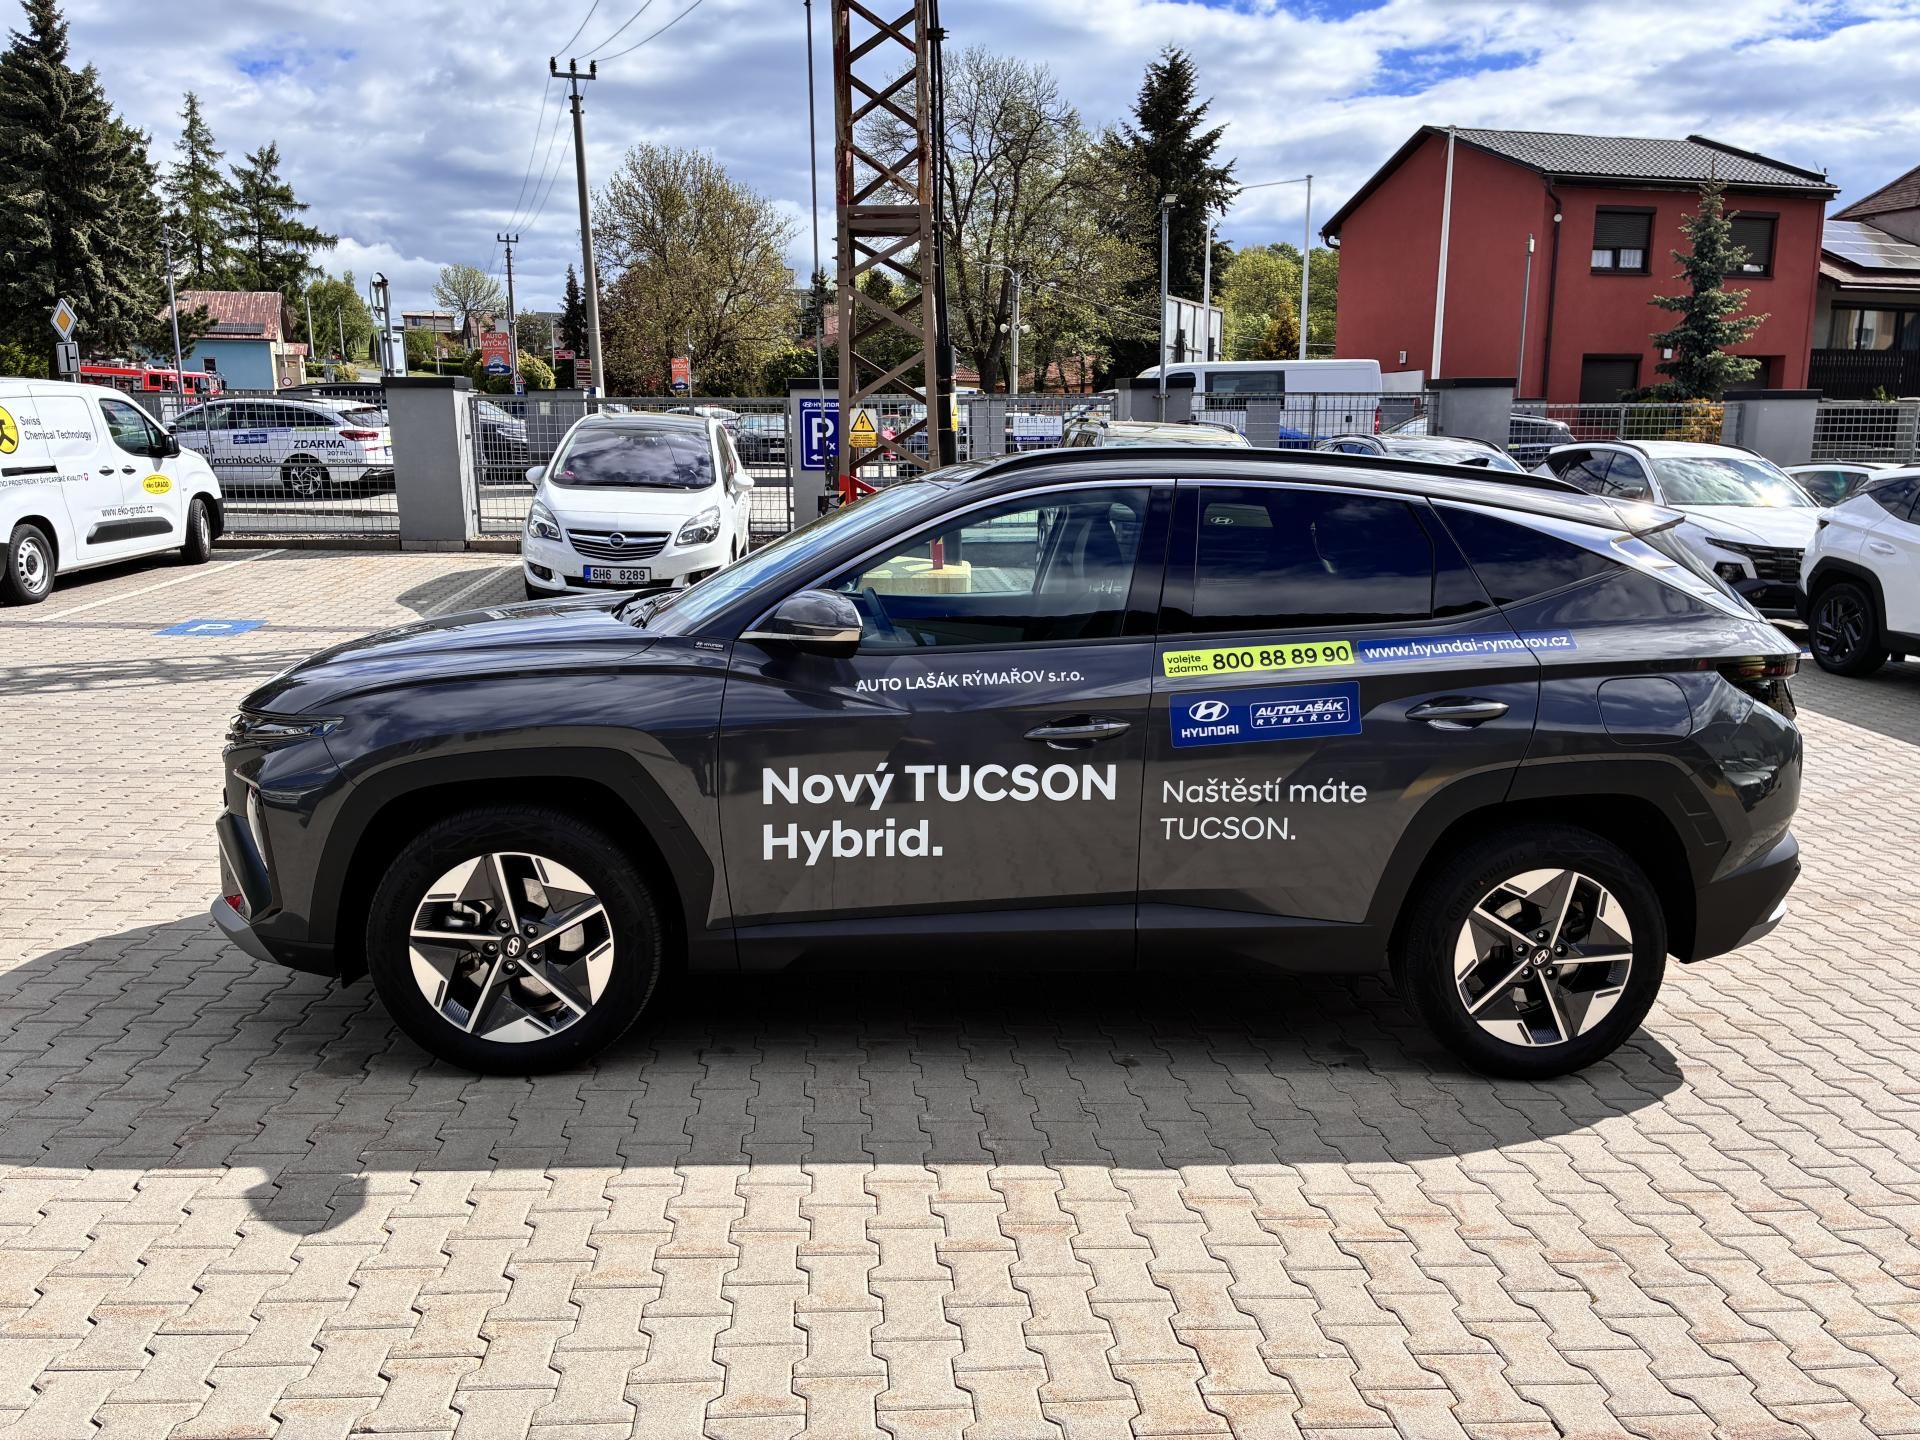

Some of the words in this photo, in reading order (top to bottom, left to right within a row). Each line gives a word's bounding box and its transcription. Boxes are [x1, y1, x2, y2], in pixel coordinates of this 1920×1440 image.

[482, 339, 508, 347] MYČKA
[20, 416, 41, 426] Swiss
[24, 430, 55, 440] Chemical
[56, 430, 92, 441] Technology
[811, 417, 835, 450] P
[294, 440, 345, 449] ZDARMA
[101, 505, 153, 518] www.eko-grado.cz
[592, 568, 612, 580] 6H6
[619, 569, 646, 581] 8289
[1364, 633, 1571, 660] www.hyundai-rymarov.cz
[1167, 654, 1202, 665] volejte
[1212, 651, 1254, 670] 800
[1259, 649, 1287, 667] 88
[1291, 647, 1318, 664] 89
[1322, 645, 1350, 662] 90
[1168, 664, 1209, 674] zdarma
[855, 677, 903, 693] AUTO
[905, 671, 960, 691] LAŠÁK
[962, 667, 1046, 688] RÝMAŘOV
[1047, 670, 1085, 684] s.r.o.
[1254, 698, 1344, 717] AUTOLAŠÁK
[1256, 712, 1346, 726] RÝMAŘOV
[1181, 724, 1240, 739] HYUNDAI
[762, 762, 896, 811] Nový
[904, 763, 1118, 802] TUCSON
[1162, 777, 1283, 804] Naštěstí
[1288, 777, 1368, 804] máte
[1160, 815, 1297, 841] TUCSON.
[762, 817, 944, 867] Hybrid.
